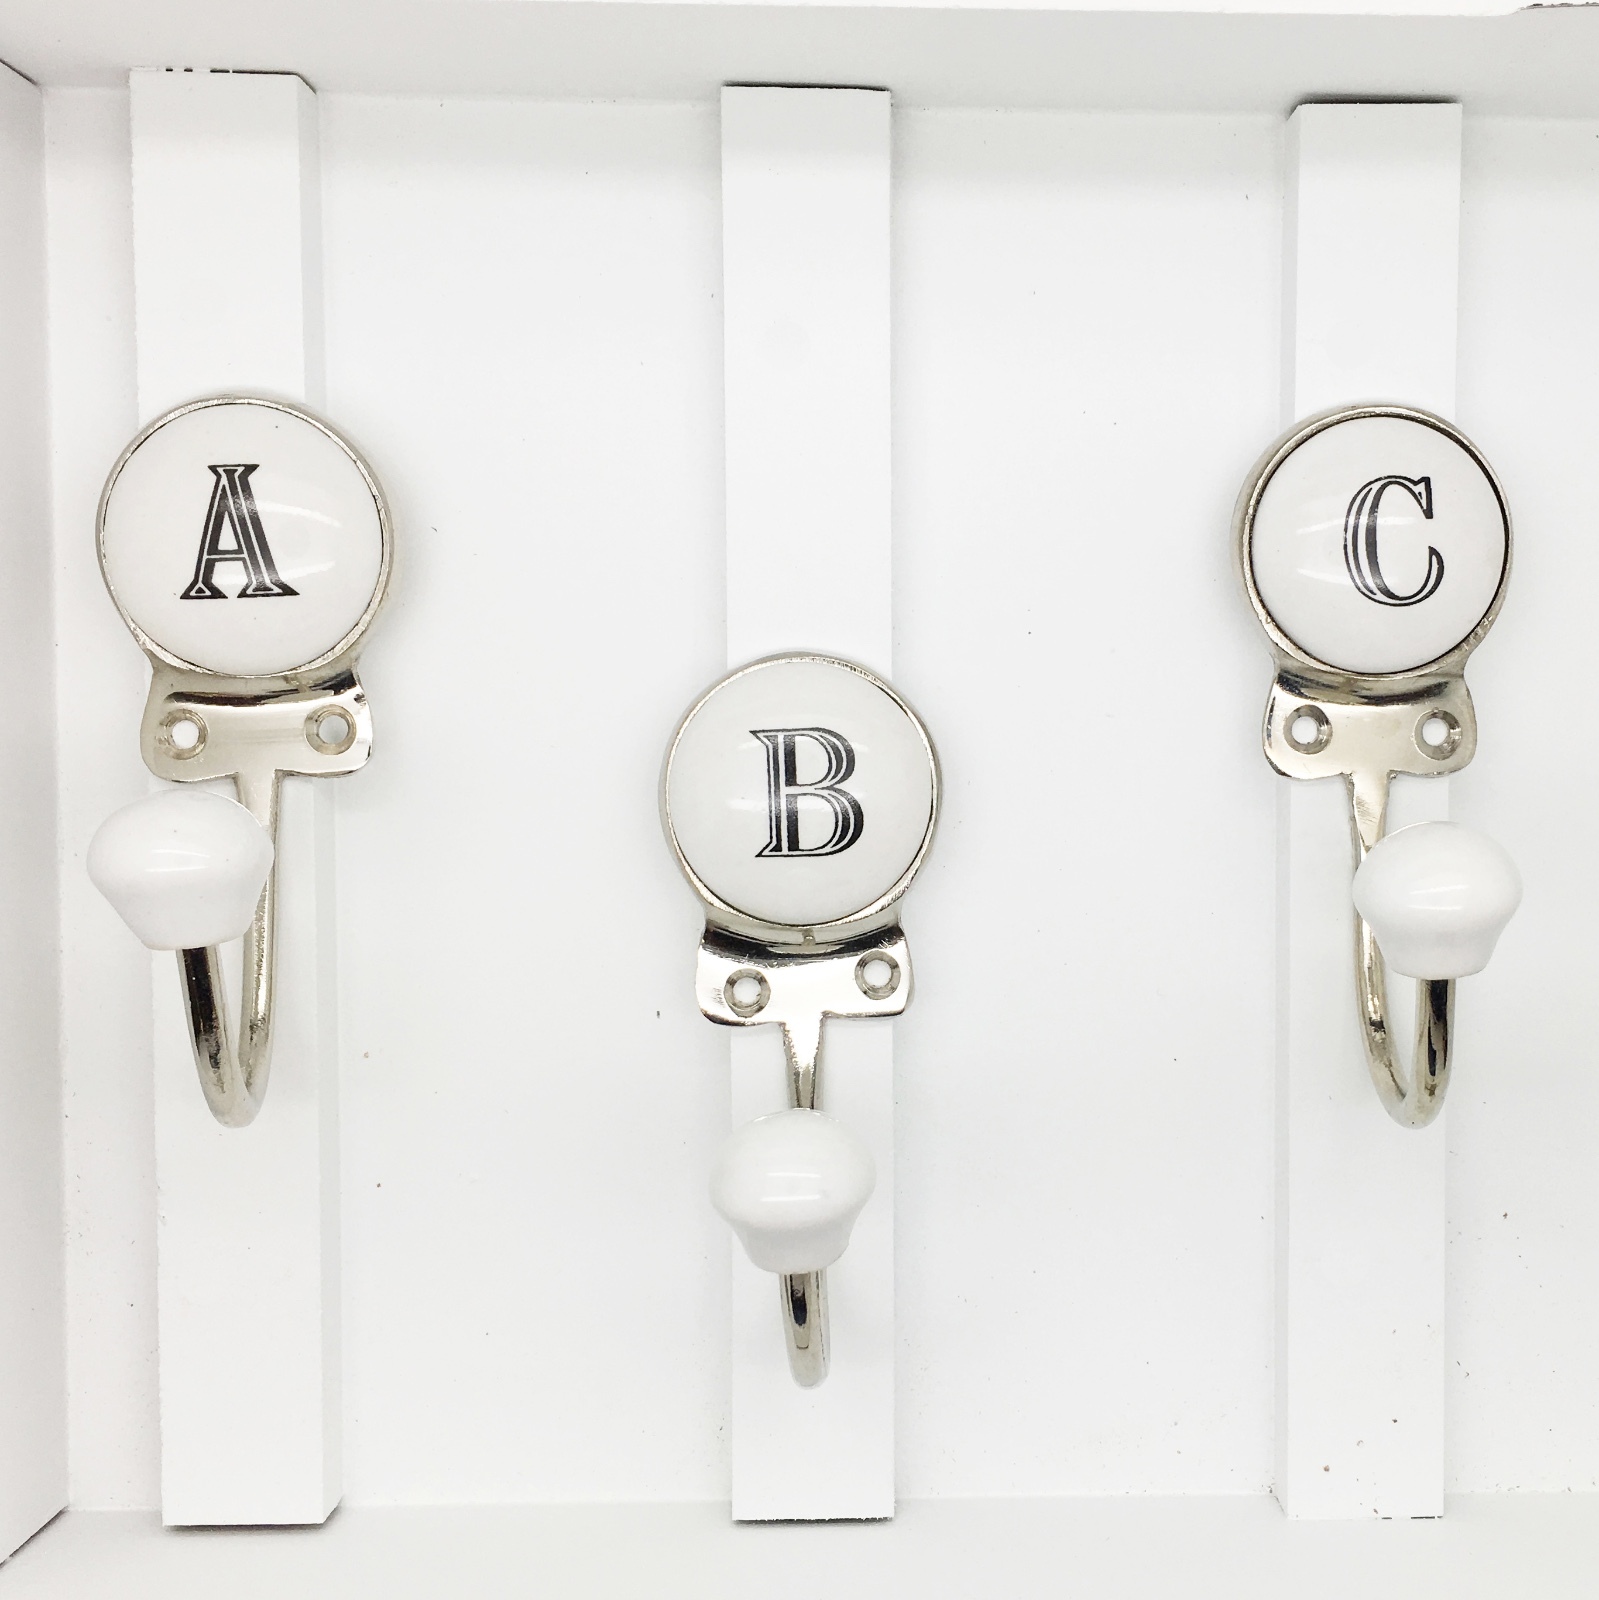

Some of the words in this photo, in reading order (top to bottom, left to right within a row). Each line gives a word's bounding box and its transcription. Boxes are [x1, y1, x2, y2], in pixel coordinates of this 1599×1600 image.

[180, 463, 300, 600] A
[1343, 475, 1444, 607] C
[749, 727, 864, 857] B
